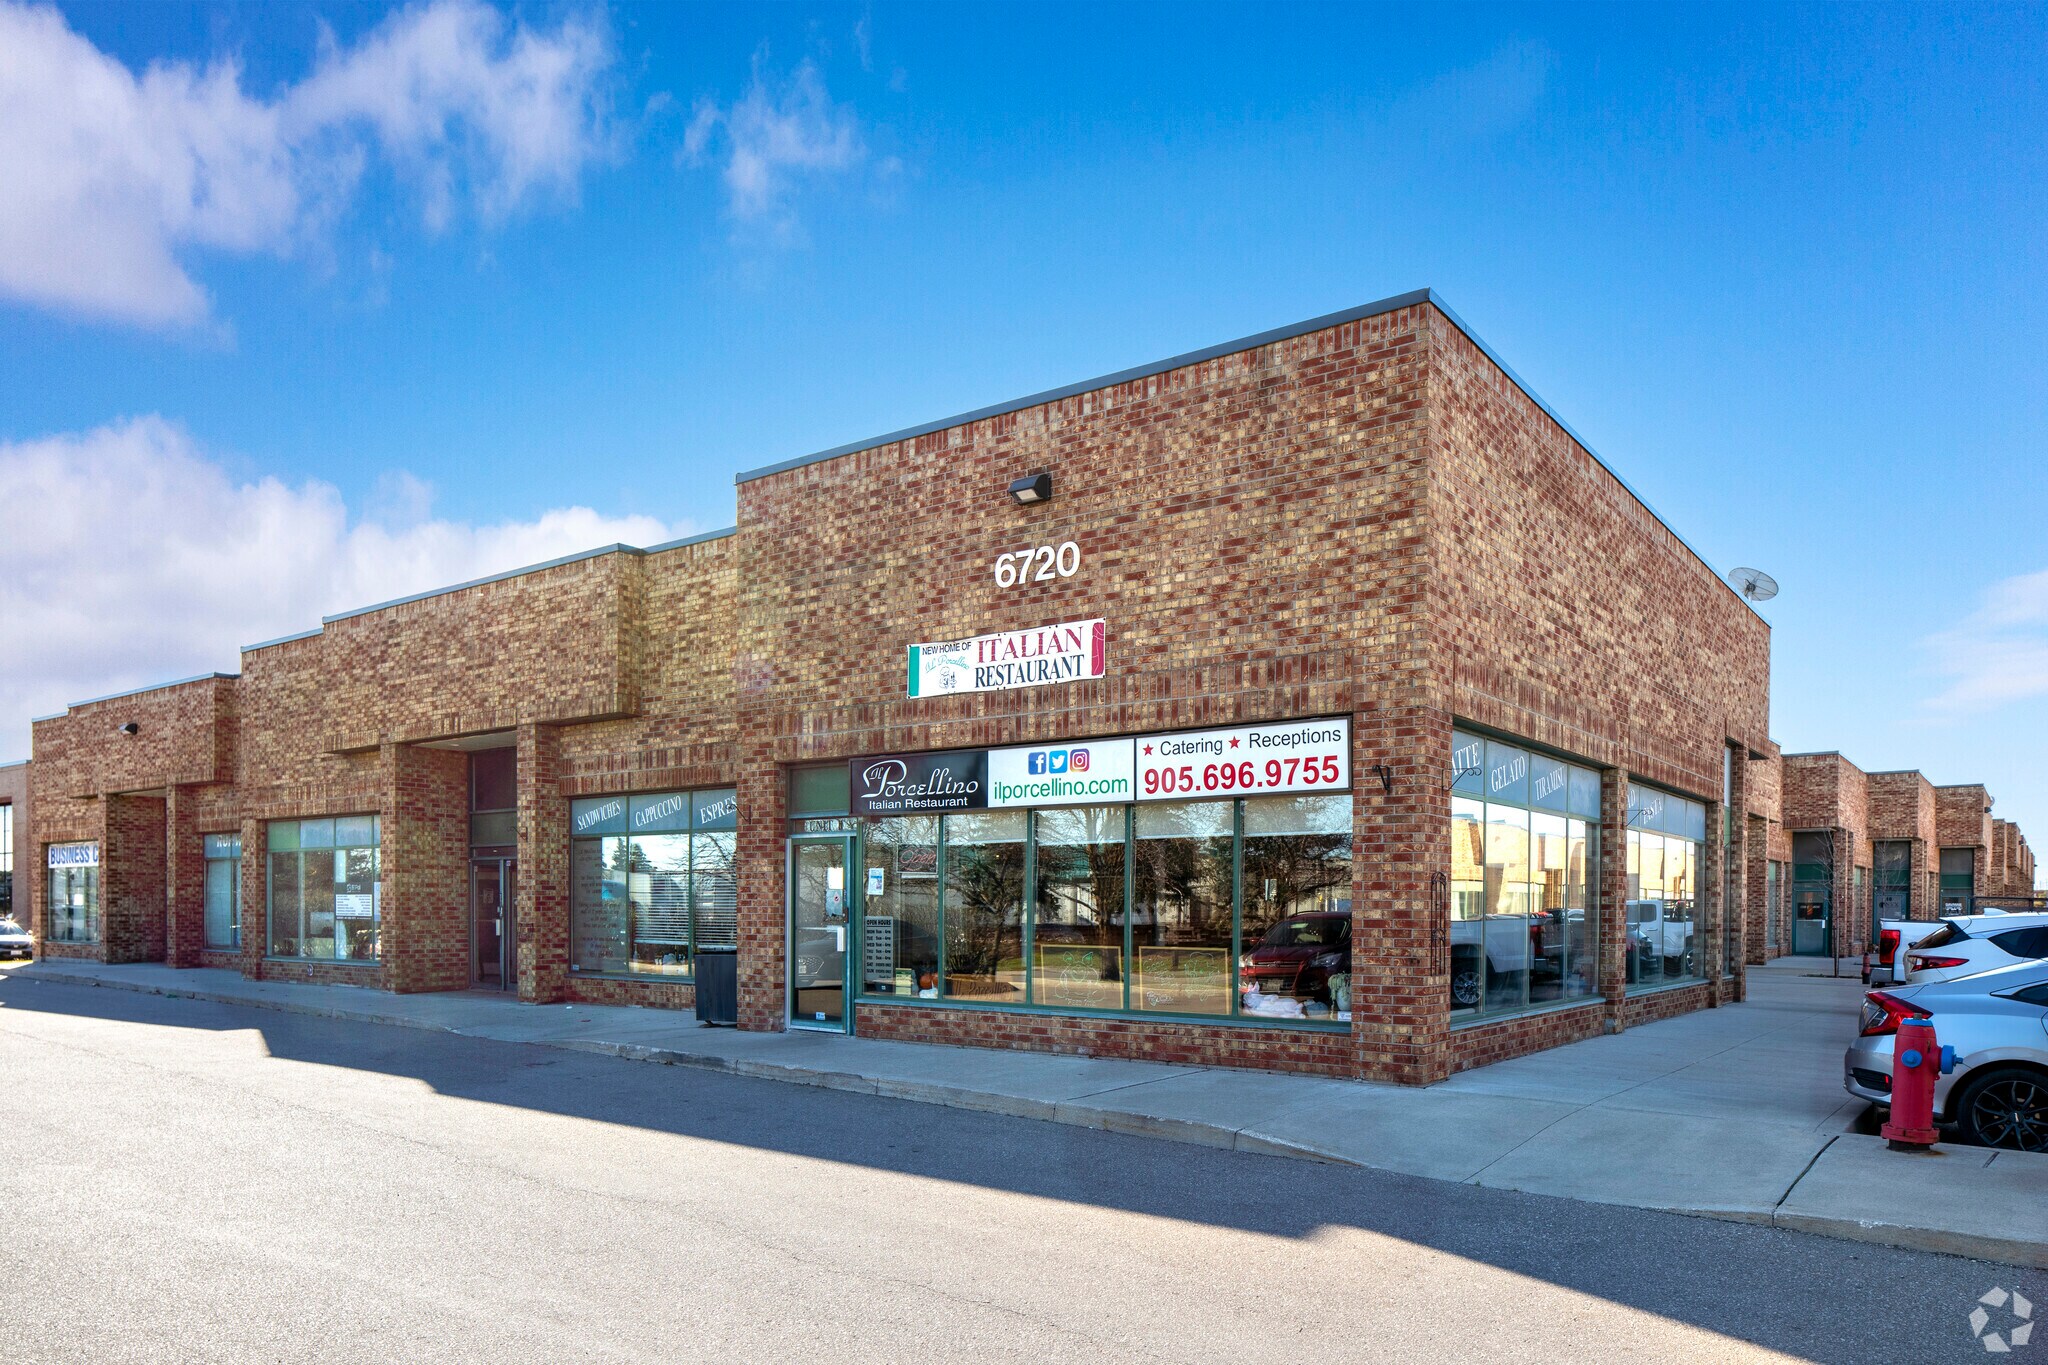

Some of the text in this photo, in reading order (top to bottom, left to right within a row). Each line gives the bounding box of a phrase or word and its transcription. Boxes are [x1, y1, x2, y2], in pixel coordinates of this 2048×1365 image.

[995, 541, 1081, 588] 6720
[922, 641, 972, 655] NEW HOME OF
[977, 626, 1084, 663] ITALIAN
[938, 654, 970, 671] Porcellino
[975, 654, 1085, 688] RESTAURANT
[1160, 728, 1342, 756] Catering Receptions
[861, 759, 979, 798] Porcellino
[1144, 755, 1340, 794] 905.696.9755
[1491, 755, 1526, 792] GELATO
[1535, 766, 1565, 800] TIRAMISU
[869, 797, 968, 810] Italian Restaurant
[994, 776, 1128, 803] ilporcellino.com
[577, 800, 621, 831] SANDWICHES
[635, 795, 682, 827] CAPPUCCINO
[700, 796, 737, 824] ESPRES
[51, 846, 90, 864] BUSINESS
